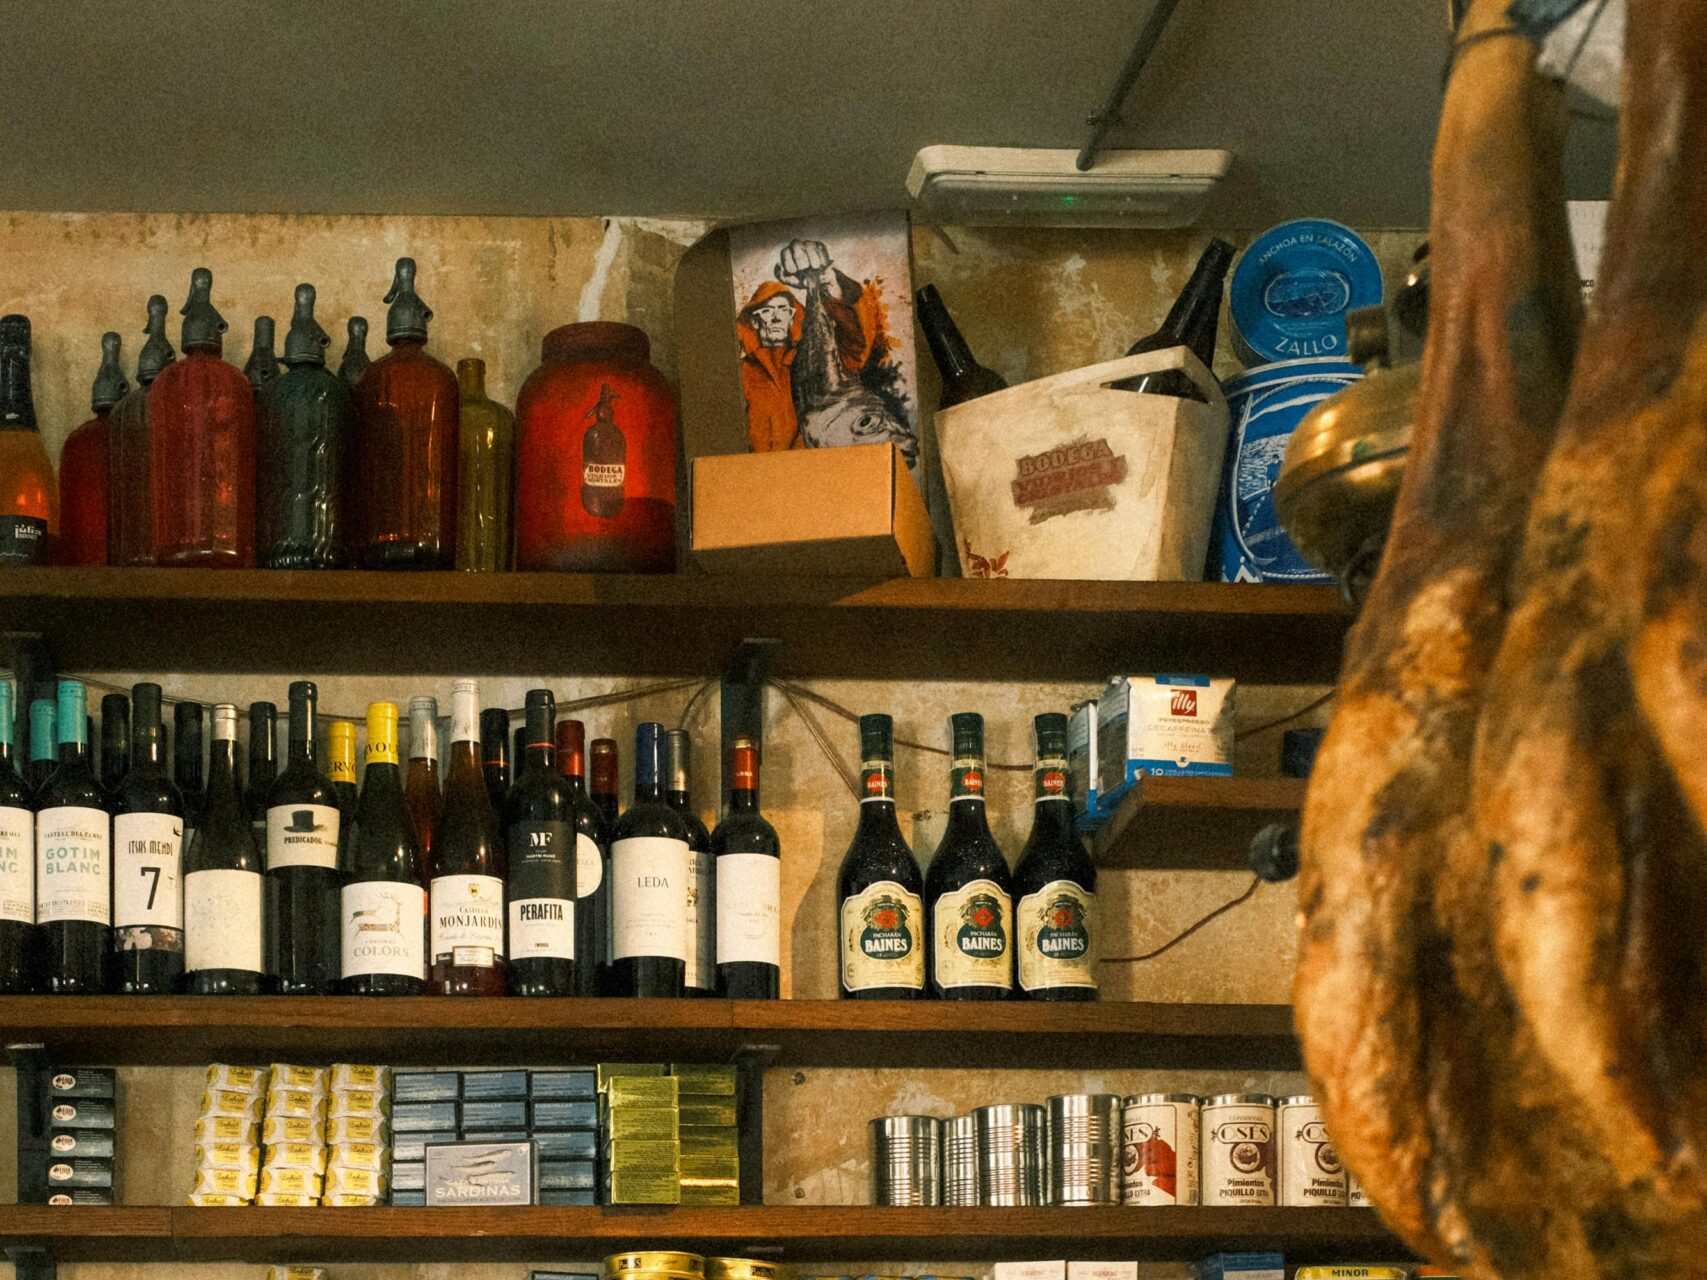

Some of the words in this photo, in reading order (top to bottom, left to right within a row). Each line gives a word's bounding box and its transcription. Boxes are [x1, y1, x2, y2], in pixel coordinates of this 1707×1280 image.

[1259, 237, 1298, 266] ANCHOA
[1299, 233, 1314, 244] EN
[1315, 234, 1359, 264] SALAZÓN
[1274, 334, 1338, 356] ZALLO
[1018, 441, 1113, 477] BODEGA
[588, 465, 623, 474] BODEGA
[1172, 691, 1195, 714] illy
[1151, 768, 1164, 776] 10
[284, 836, 322, 844] PREDICADOR
[529, 832, 553, 847] MF
[46, 847, 100, 860] GOTIM
[149, 840, 173, 856] MENDI
[46, 862, 100, 875] BLANC
[140, 866, 162, 910] 7
[637, 876, 670, 889] LEDA
[520, 903, 563, 921] PERAFITA
[353, 945, 409, 957] COLORS
[865, 938, 908, 953] BAINES
[962, 937, 1004, 951] BAINES
[1042, 938, 1085, 952] BAINES
[1227, 1179, 1265, 1187] Pimientos
[436, 1184, 521, 1199] SARDINAS
[1219, 1188, 1255, 1198] PIQUILLO
[1303, 1188, 1337, 1197] PIQUILLO
[1331, 1269, 1369, 1277] MINOR
